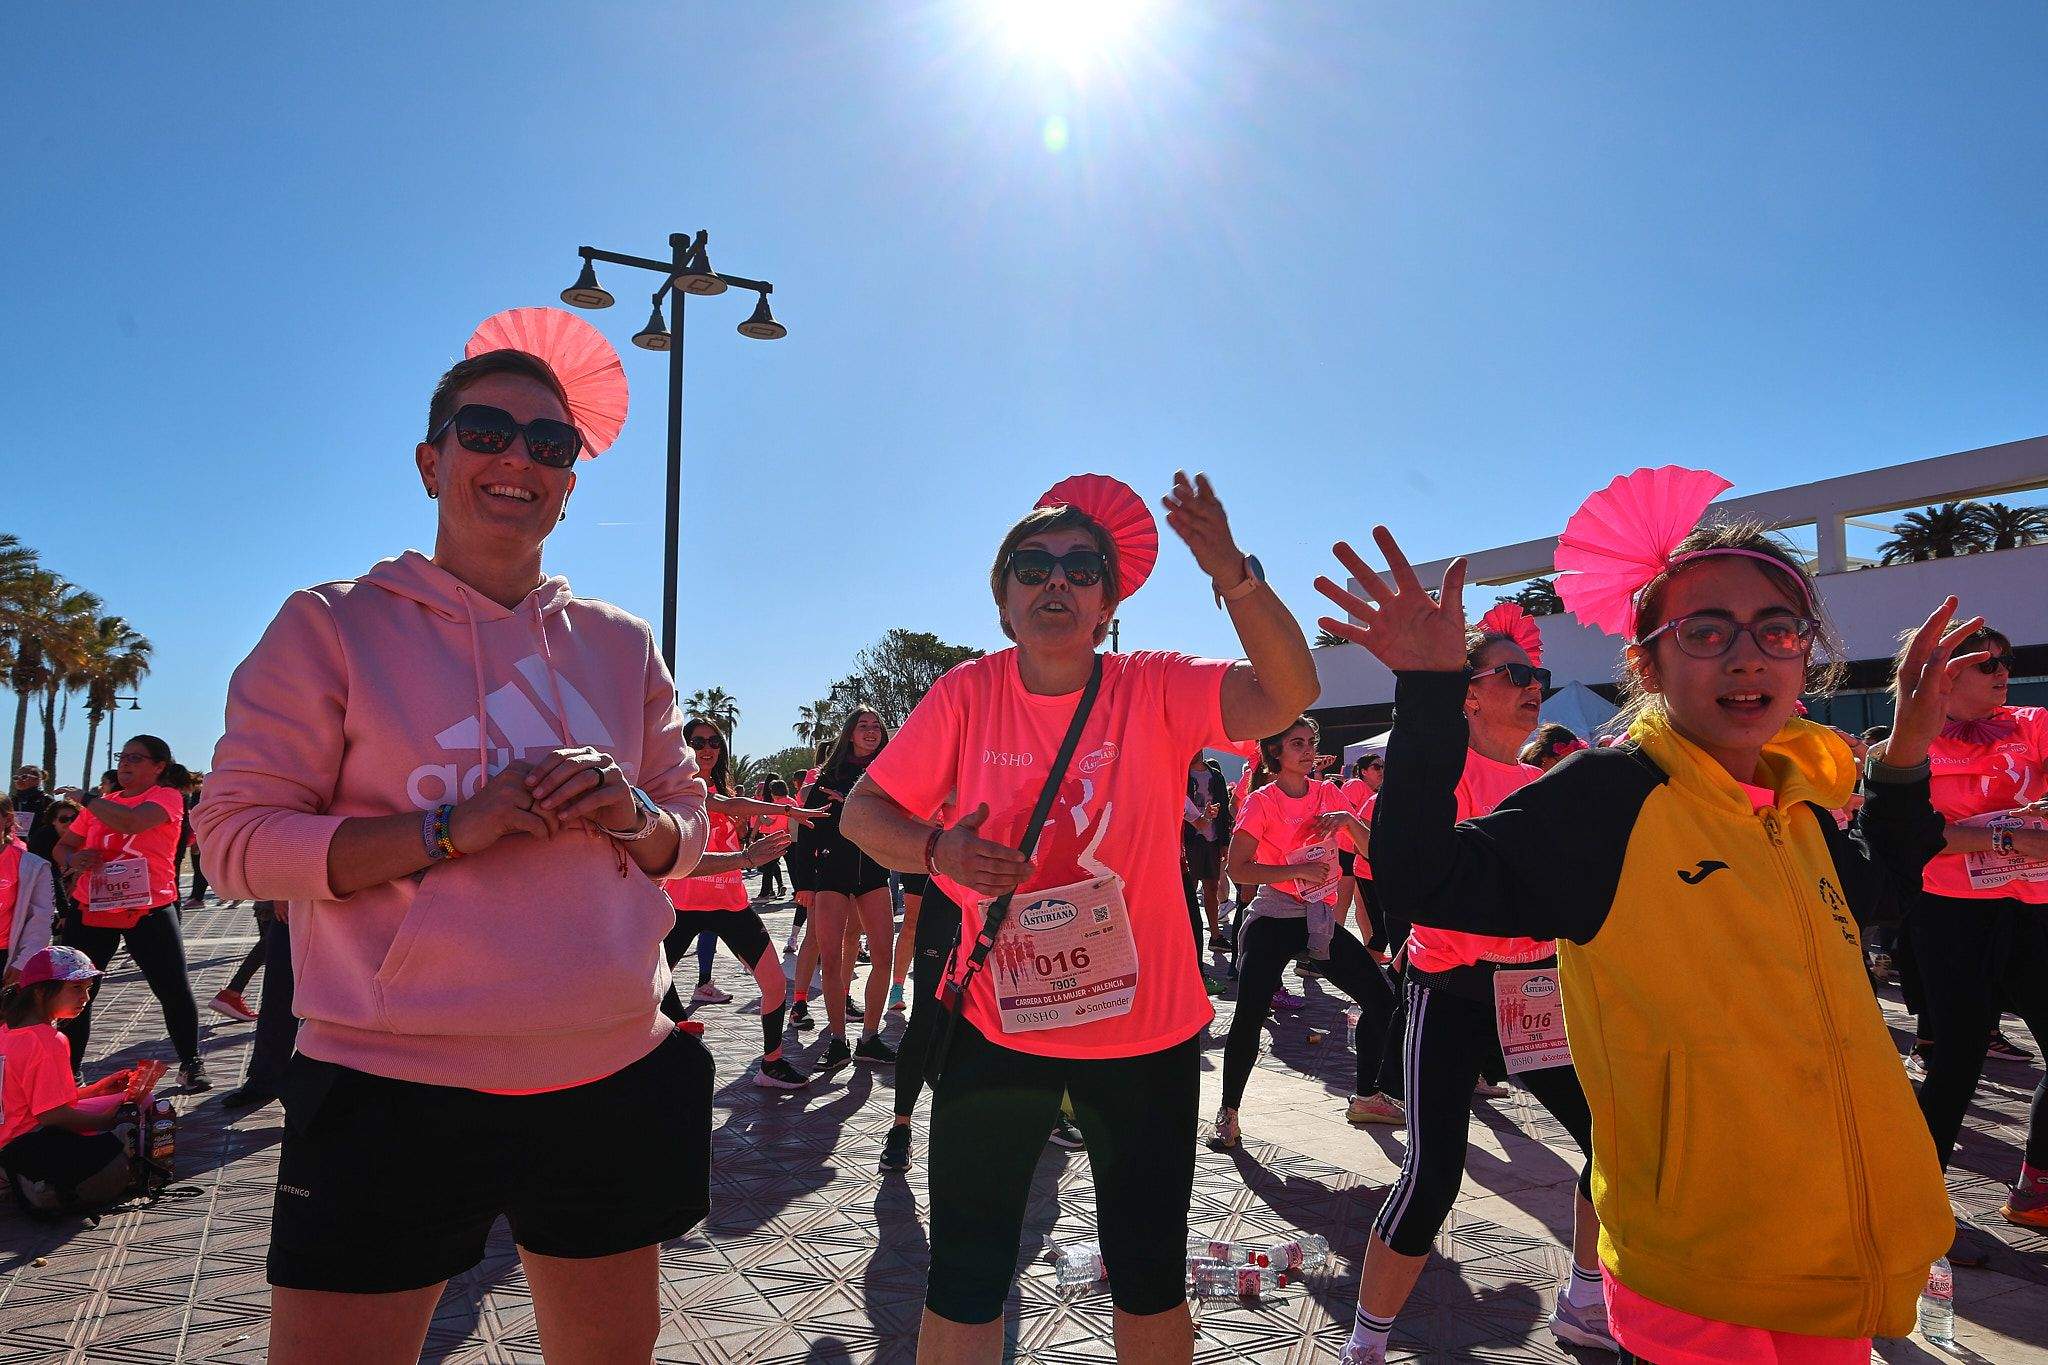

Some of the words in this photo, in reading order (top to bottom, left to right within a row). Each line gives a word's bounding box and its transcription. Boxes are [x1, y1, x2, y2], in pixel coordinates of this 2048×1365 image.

[1024, 909, 1074, 926] ASTURIANA
[1035, 946, 1091, 977] 016
[1015, 997, 1042, 1006] CARRERA
[1053, 994, 1063, 1002] LA
[1063, 990, 1087, 1001] MUJER
[1092, 979, 1124, 993] VALENCIA
[1050, 977, 1077, 991] 7903
[1087, 997, 1130, 1013] Santander
[1016, 1009, 1059, 1024] OYSHO
[1522, 1012, 1552, 1030] 016
